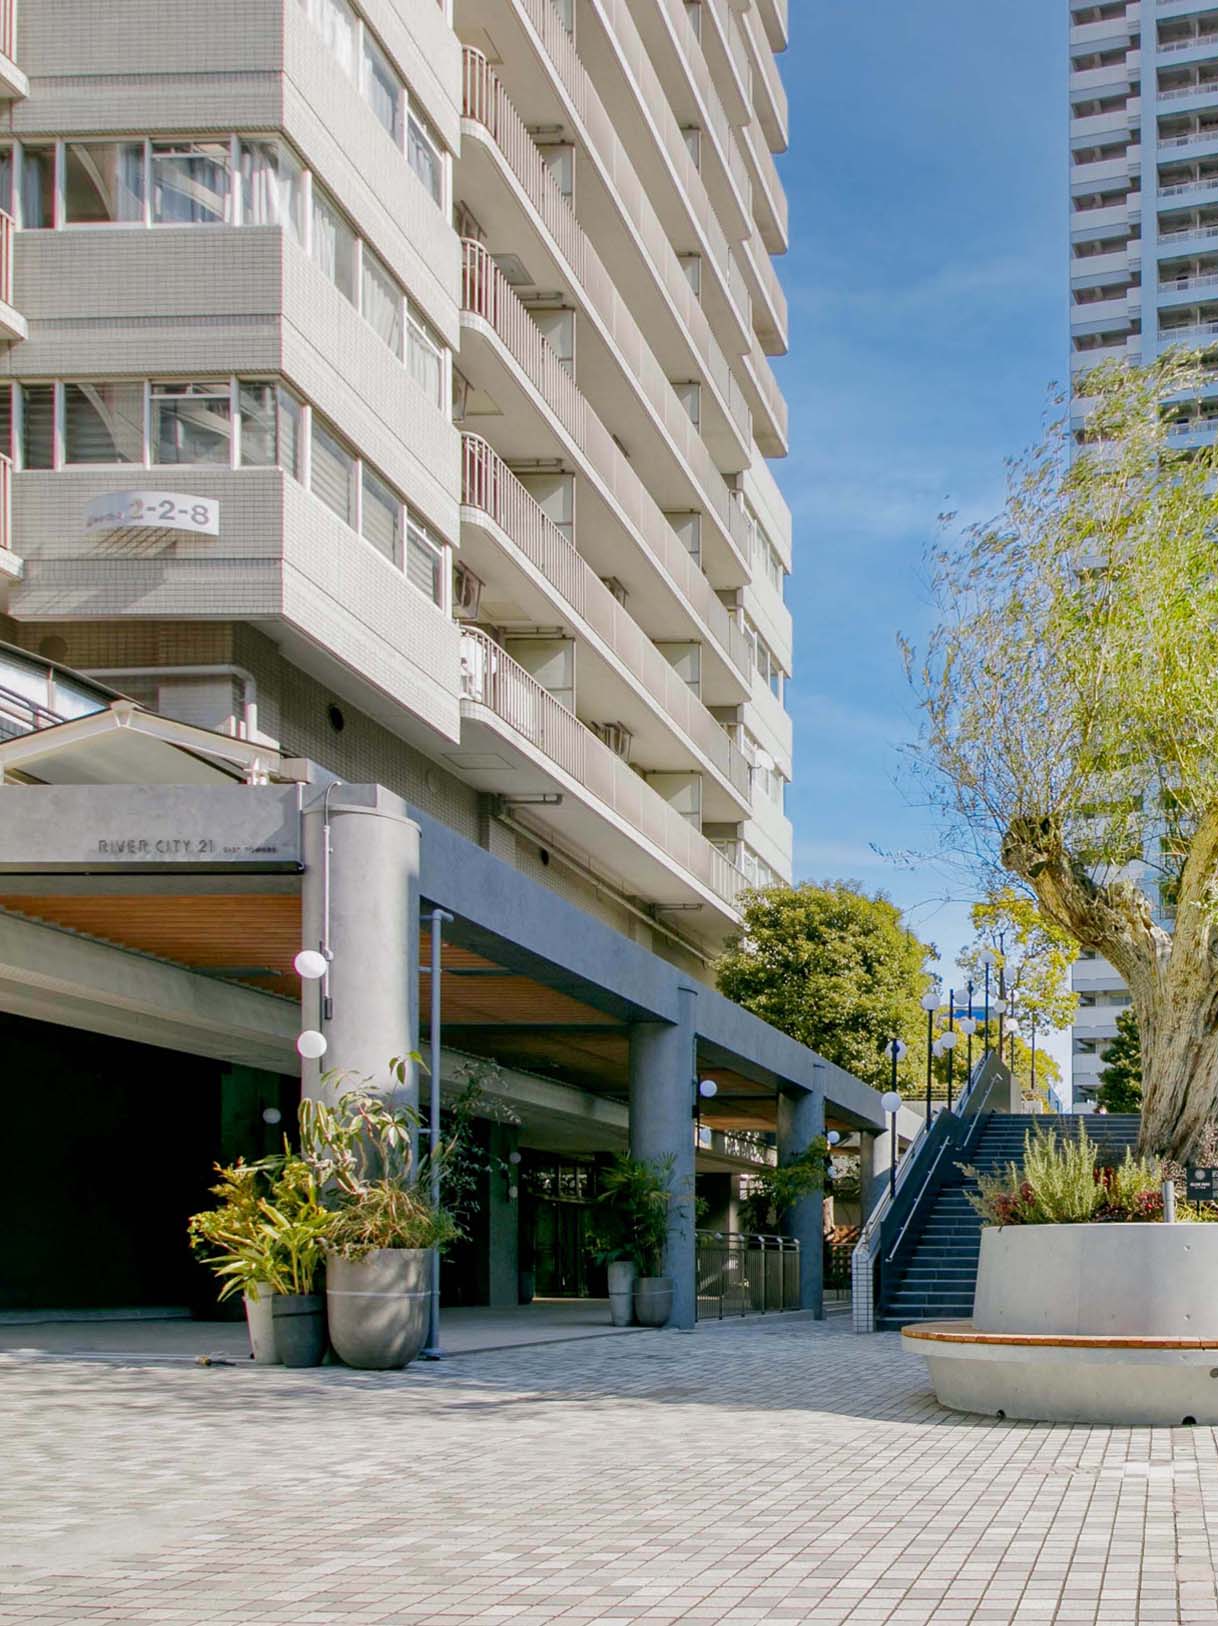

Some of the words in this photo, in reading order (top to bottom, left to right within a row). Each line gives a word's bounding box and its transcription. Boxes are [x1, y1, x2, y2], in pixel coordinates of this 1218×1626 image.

[129, 498, 210, 526] 2-2-8
[98, 839, 149, 853] RIVER
[155, 839, 192, 853] CITY
[199, 839, 214, 853] 21
